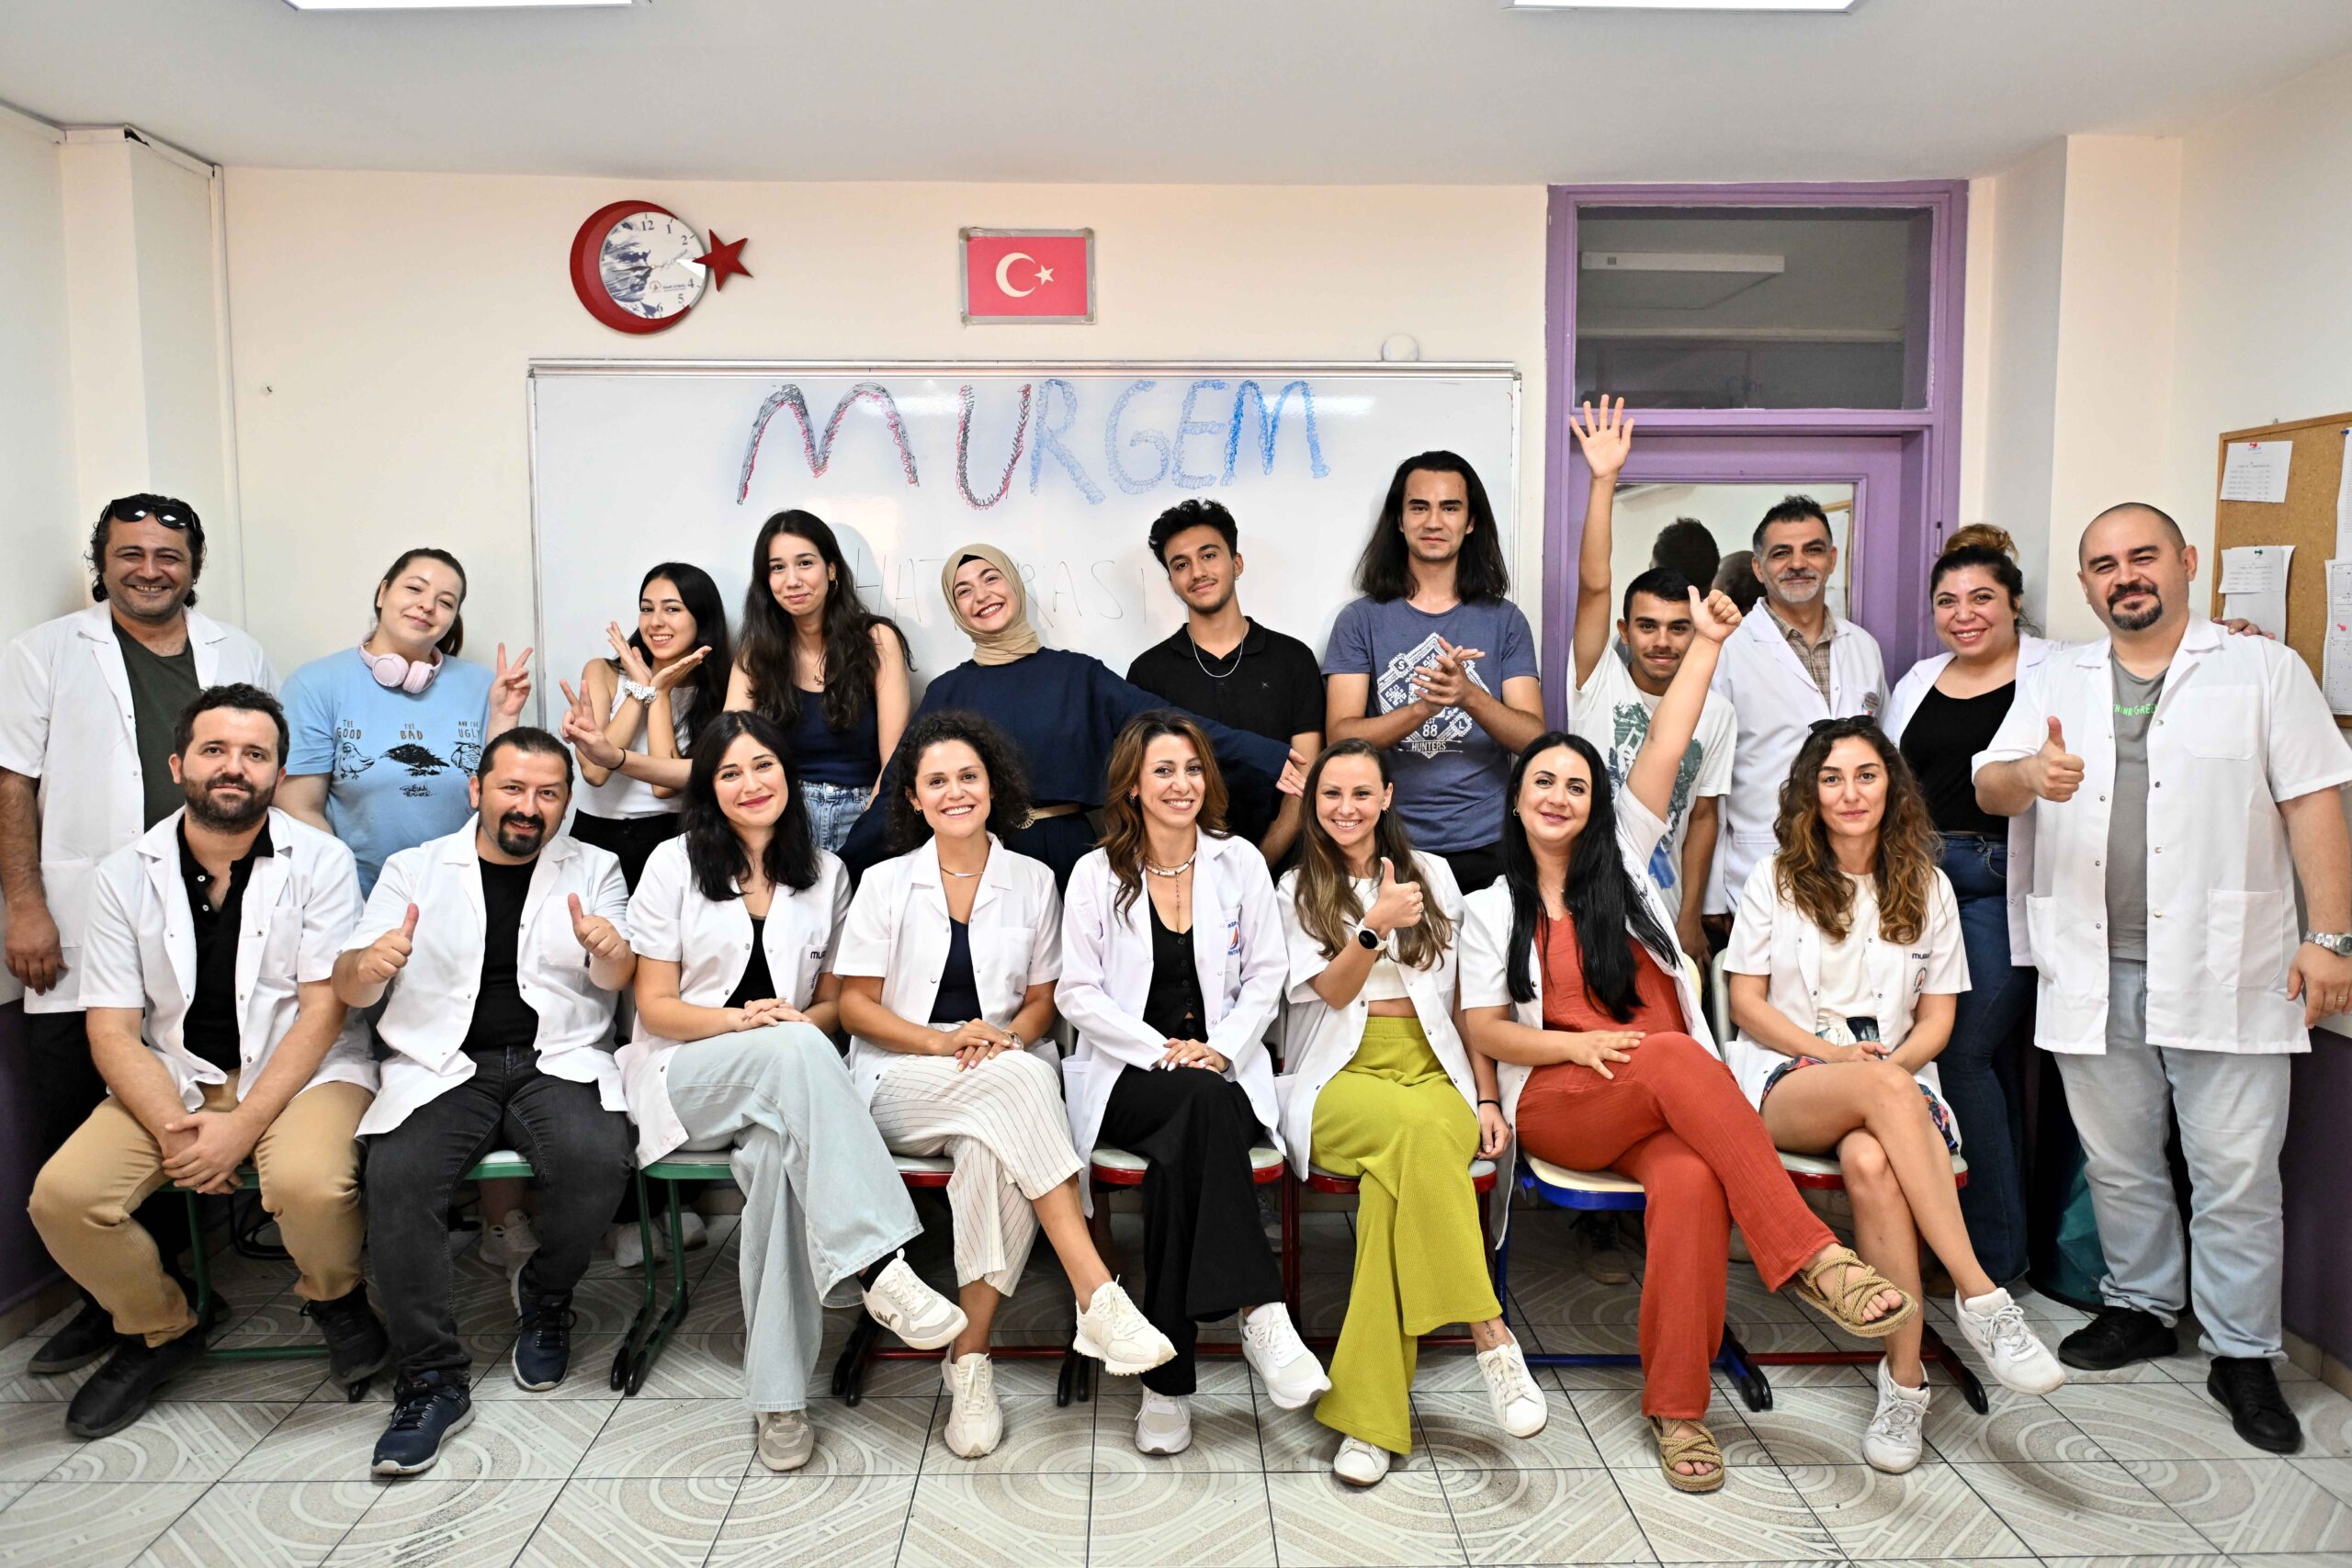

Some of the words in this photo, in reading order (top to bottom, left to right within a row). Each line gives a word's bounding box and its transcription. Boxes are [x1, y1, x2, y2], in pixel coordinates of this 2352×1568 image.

[641, 220, 654, 231] 12
[667, 224, 672, 233] 1
[681, 235, 688, 245] 2
[687, 278, 695, 288] 4
[678, 294, 684, 304] 5
[657, 303, 663, 312] 6
[737, 379, 1330, 510] MURGEM
[1397, 660, 1405, 671] S
[343, 719, 354, 728] THE
[1458, 720, 1464, 729] L
[336, 727, 362, 740] GOOD
[400, 729, 424, 740] BAD
[458, 728, 481, 739] UGLY
[1422, 724, 1438, 737] 88
[1411, 741, 1447, 750] HUNTERS
